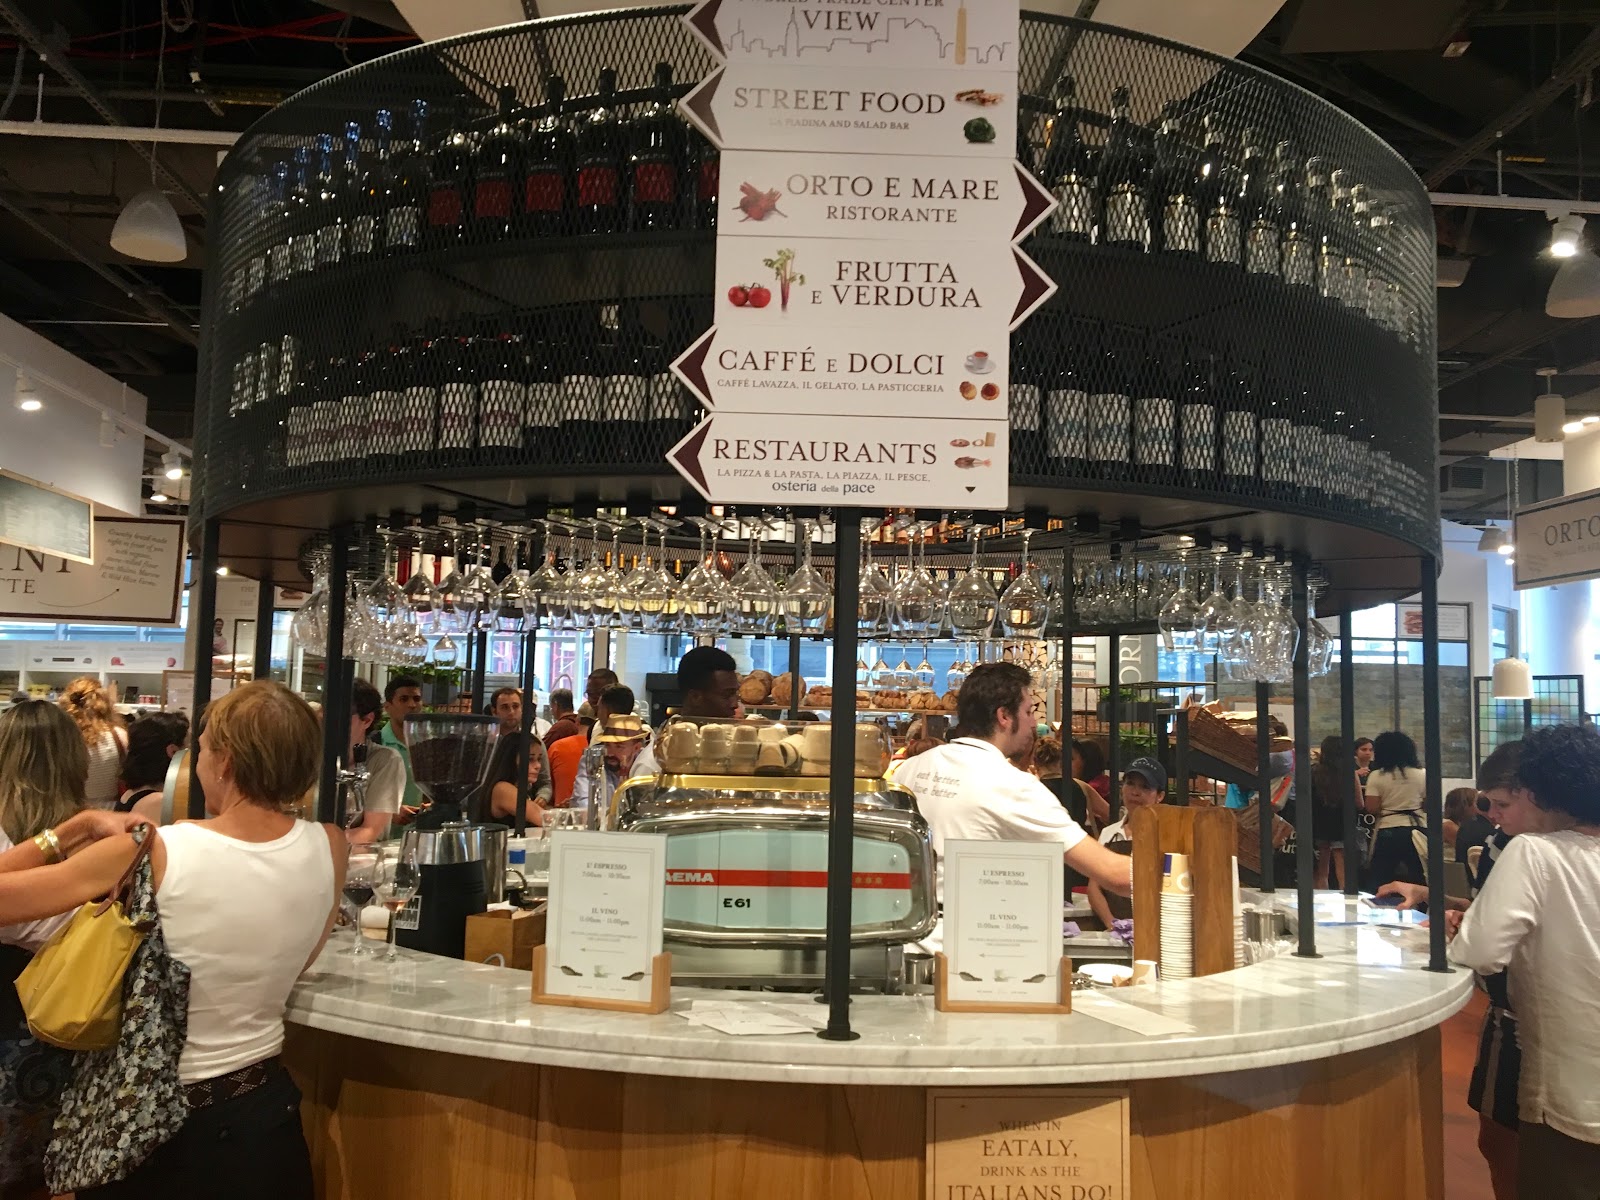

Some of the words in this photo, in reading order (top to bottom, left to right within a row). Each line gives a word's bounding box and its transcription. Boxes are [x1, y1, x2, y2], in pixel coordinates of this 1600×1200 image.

[801, 10, 880, 31] VIEW
[734, 87, 850, 111] STREET
[859, 92, 945, 114] FOOD
[828, 120, 851, 128] AND
[853, 121, 887, 129] SALAD
[890, 122, 910, 130] BAR
[787, 173, 873, 197] ORTO
[884, 177, 900, 198] E
[911, 178, 999, 200] MARE
[826, 205, 957, 223] RISTORANTE
[836, 260, 959, 283] FRUTTA
[810, 290, 822, 305] E
[830, 284, 982, 308] VERDURA
[718, 346, 816, 372] CAFFÉ
[826, 359, 837, 373] E
[848, 353, 944, 375] DOLCI
[717, 378, 750, 388] CAFFÉ
[802, 381, 813, 389] IL
[862, 382, 875, 391] LA
[877, 383, 944, 393] PASTICCERIA
[713, 439, 937, 465] RESTAURANTS
[717, 468, 731, 477] LA
[733, 469, 762, 477] PIZZA
[764, 470, 771, 478] &
[774, 470, 787, 478] LA
[826, 471, 840, 480] LA
[884, 473, 895, 481] IL
[772, 480, 817, 492] osteria
[821, 485, 839, 493] della
[843, 483, 875, 495] pace
[998, 1120, 1042, 1131] WHEN
[1045, 1120, 1062, 1131] IN
[982, 1139, 1078, 1158] EATALY,
[980, 1166, 1027, 1177] DRINK
[1029, 1166, 1048, 1177] AS
[1051, 1166, 1081, 1177] THE
[947, 1185, 1062, 1200] ITALIANS
